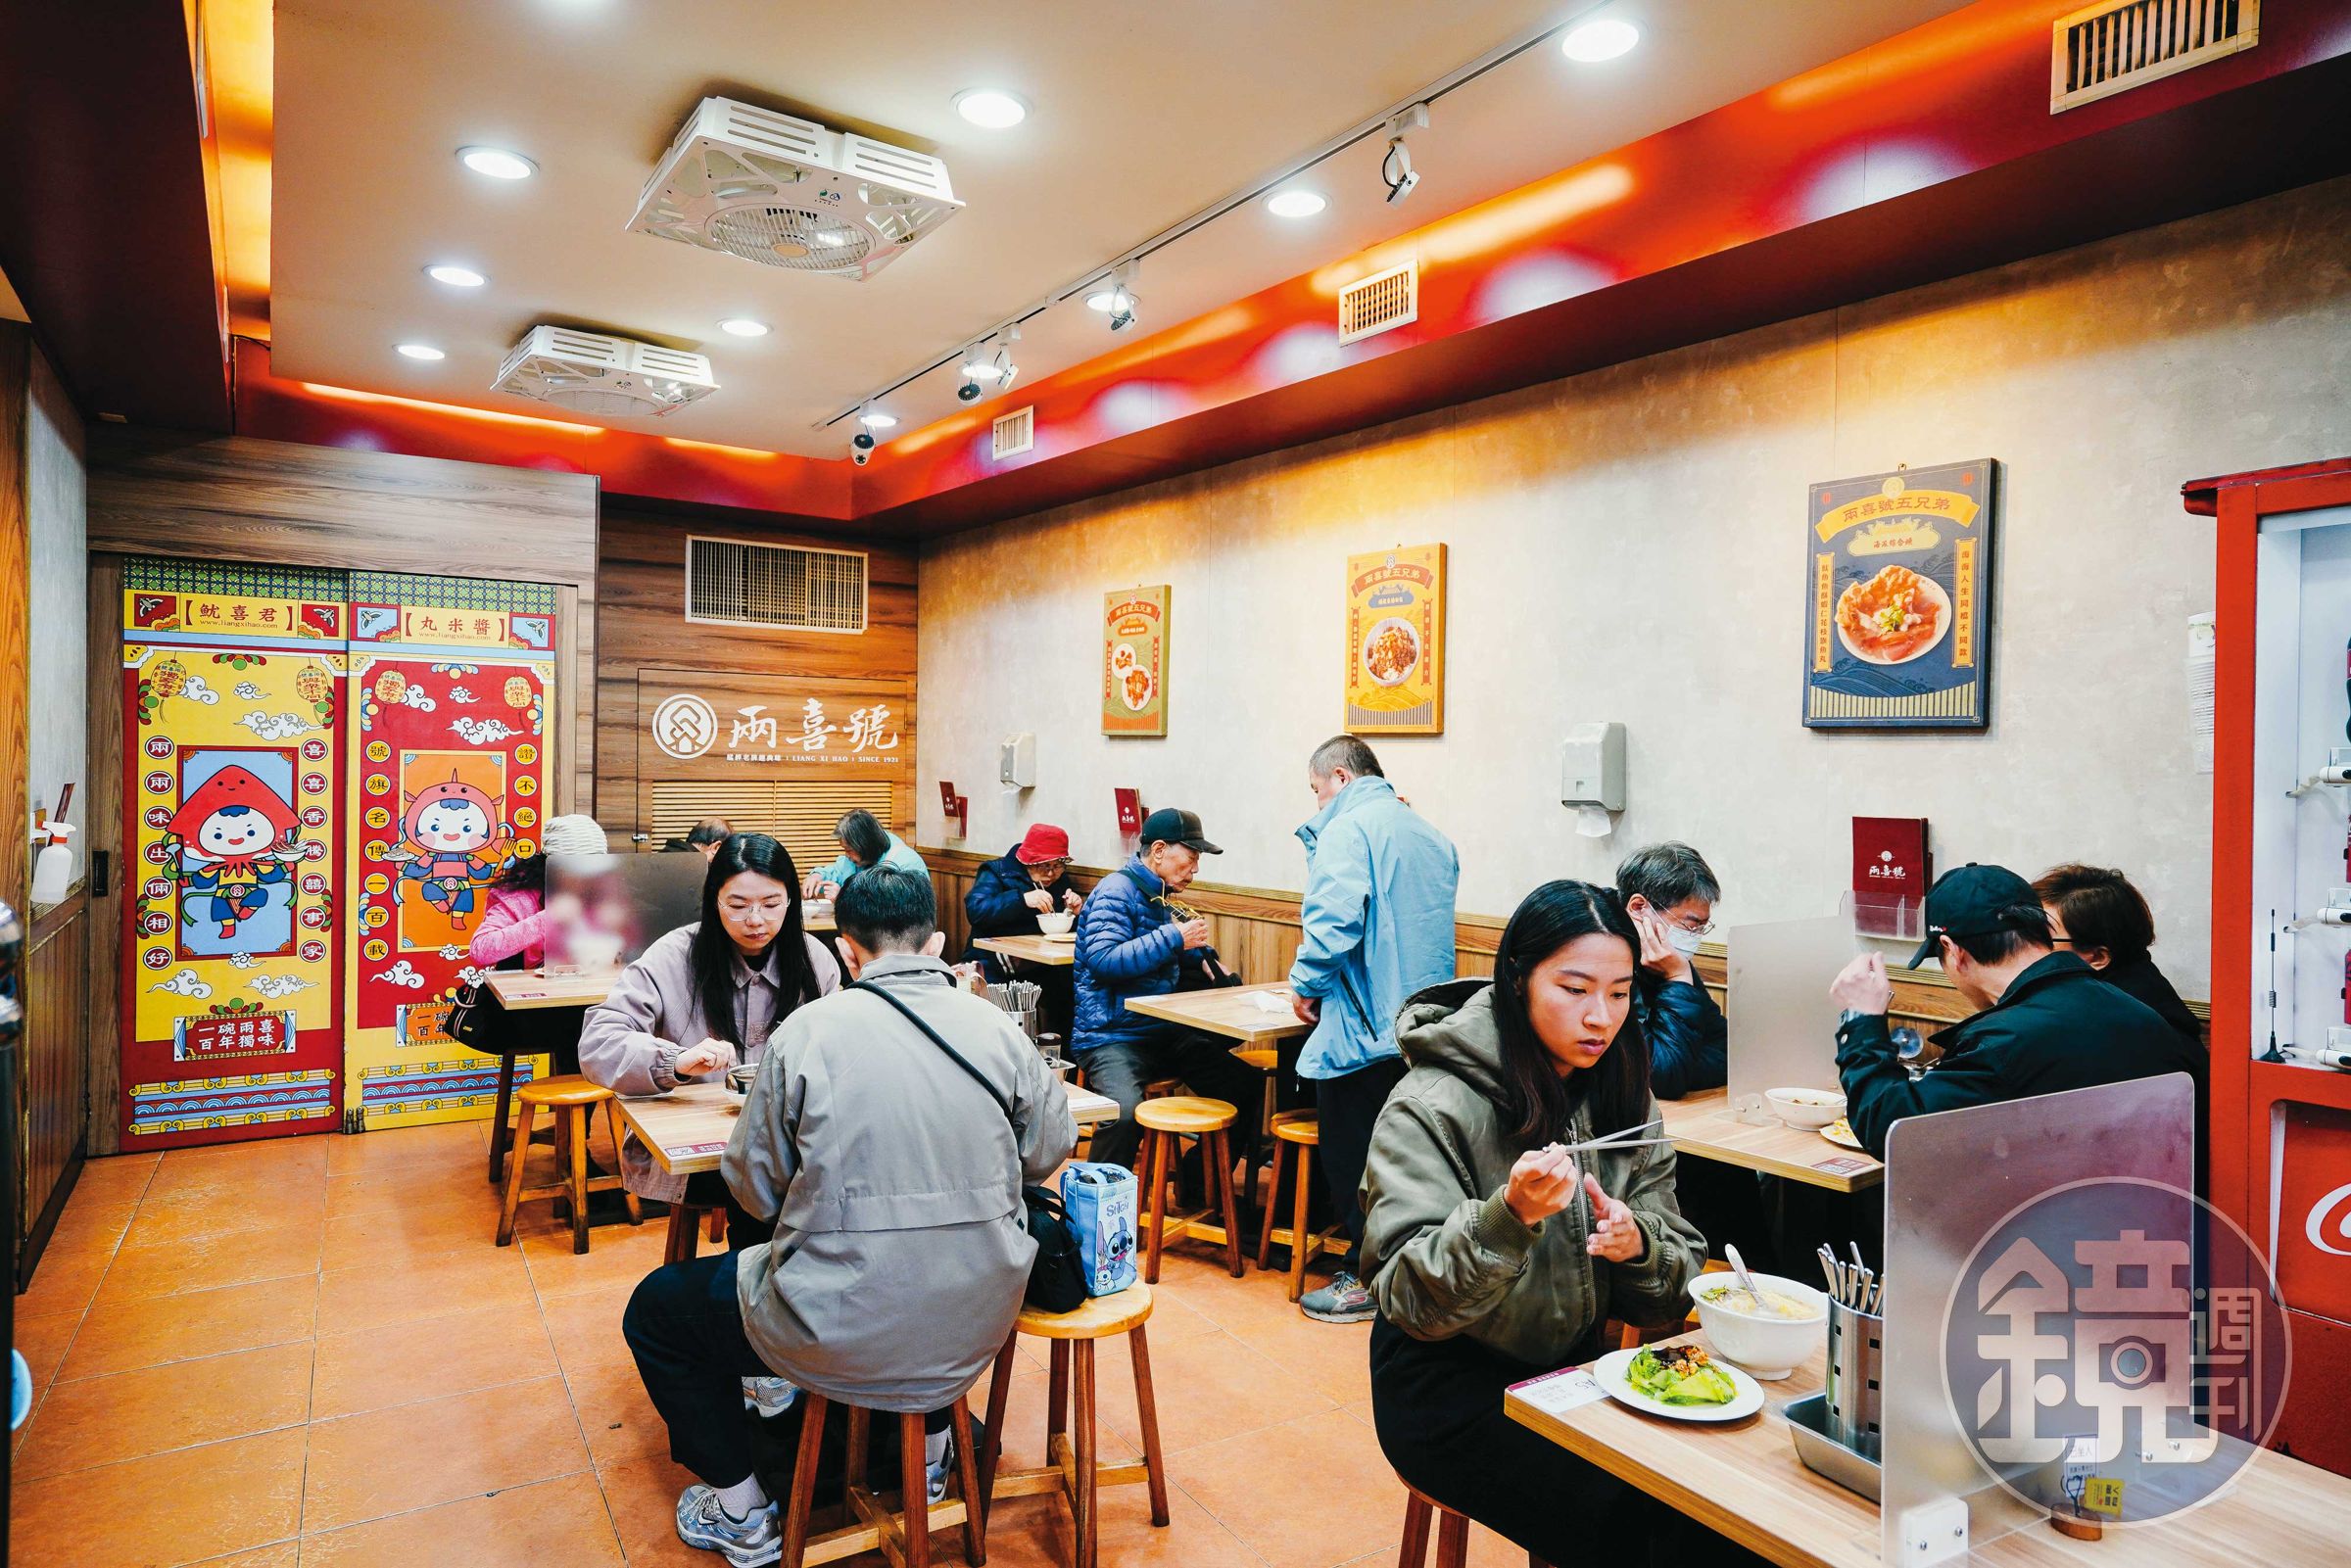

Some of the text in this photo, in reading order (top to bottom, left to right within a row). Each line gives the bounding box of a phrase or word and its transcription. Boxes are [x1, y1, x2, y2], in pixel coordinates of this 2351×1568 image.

[1843, 496, 1950, 523] 兩喜號五兄弟
[728, 697, 899, 753] 兩喜號
[198, 1019, 275, 1036] 一碗兩喜
[199, 1032, 276, 1051] 百年獨味
